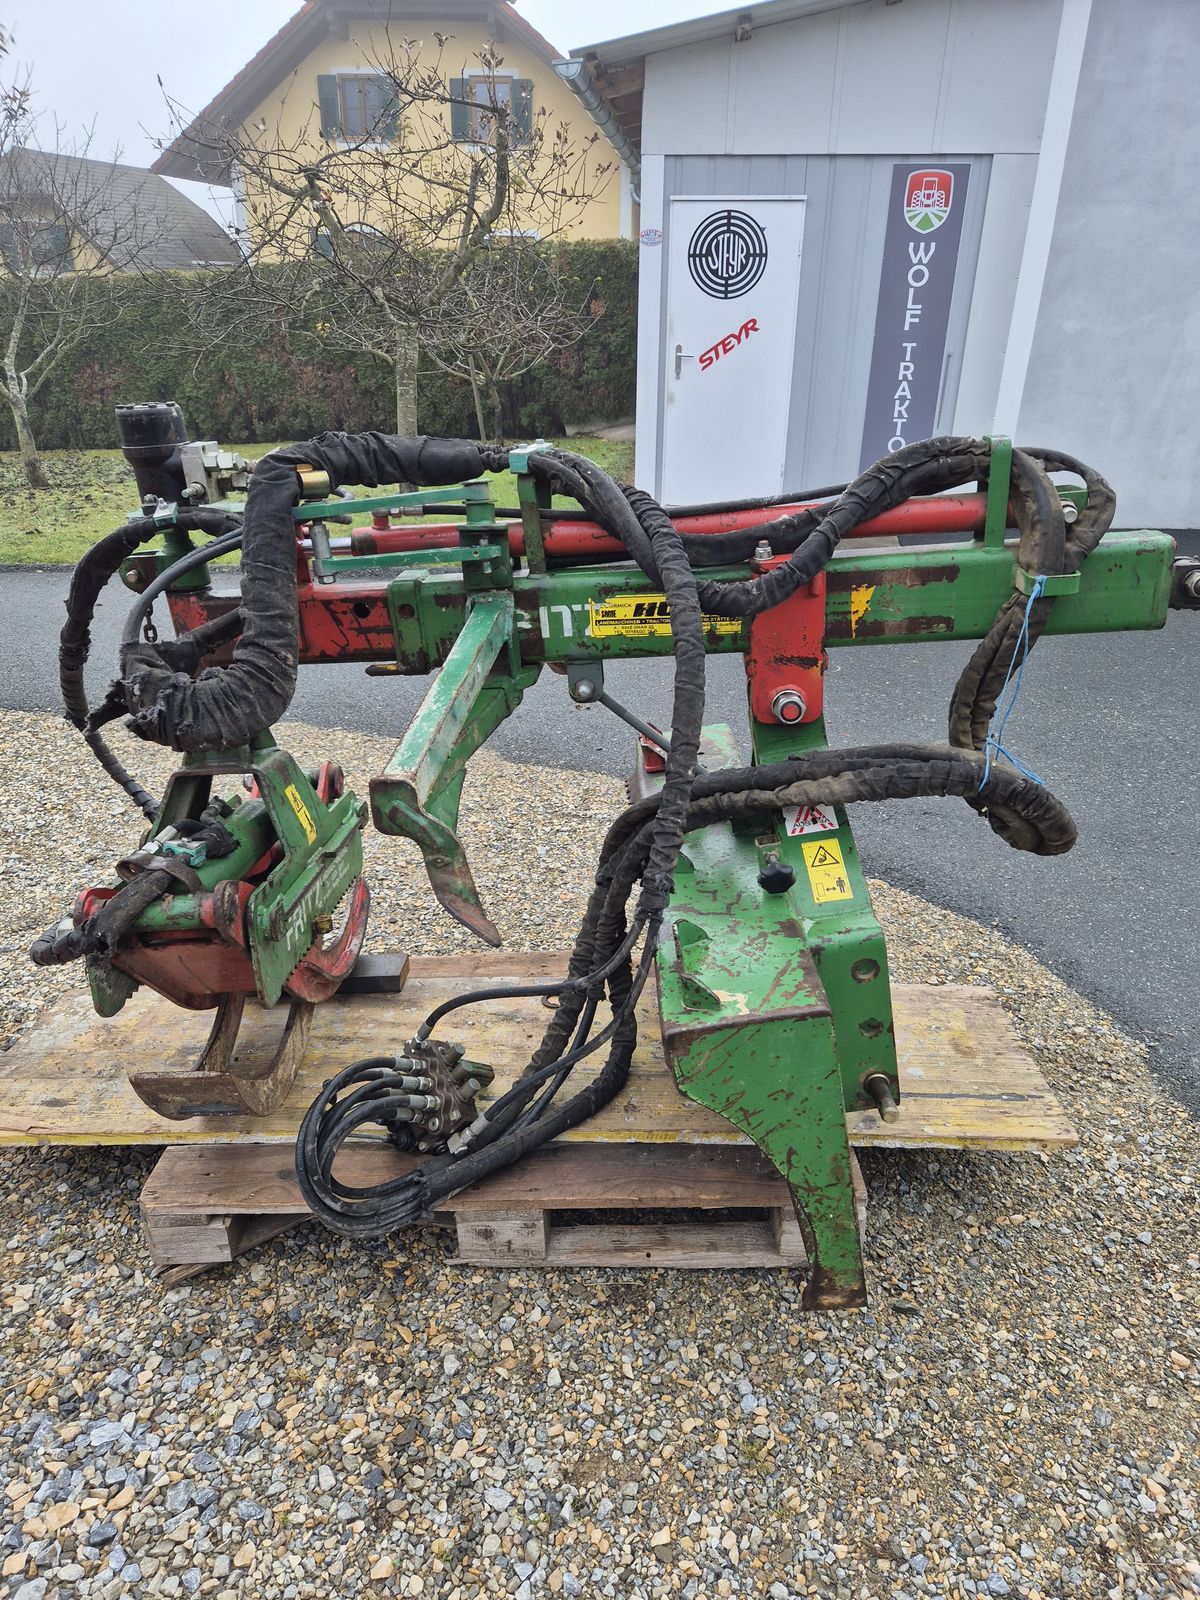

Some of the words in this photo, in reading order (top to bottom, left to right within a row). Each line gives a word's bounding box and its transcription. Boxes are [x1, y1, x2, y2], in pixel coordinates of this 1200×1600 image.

[707, 232, 747, 278] STEYR
[903, 241, 936, 331] WOLF
[698, 318, 760, 372] STEYR
